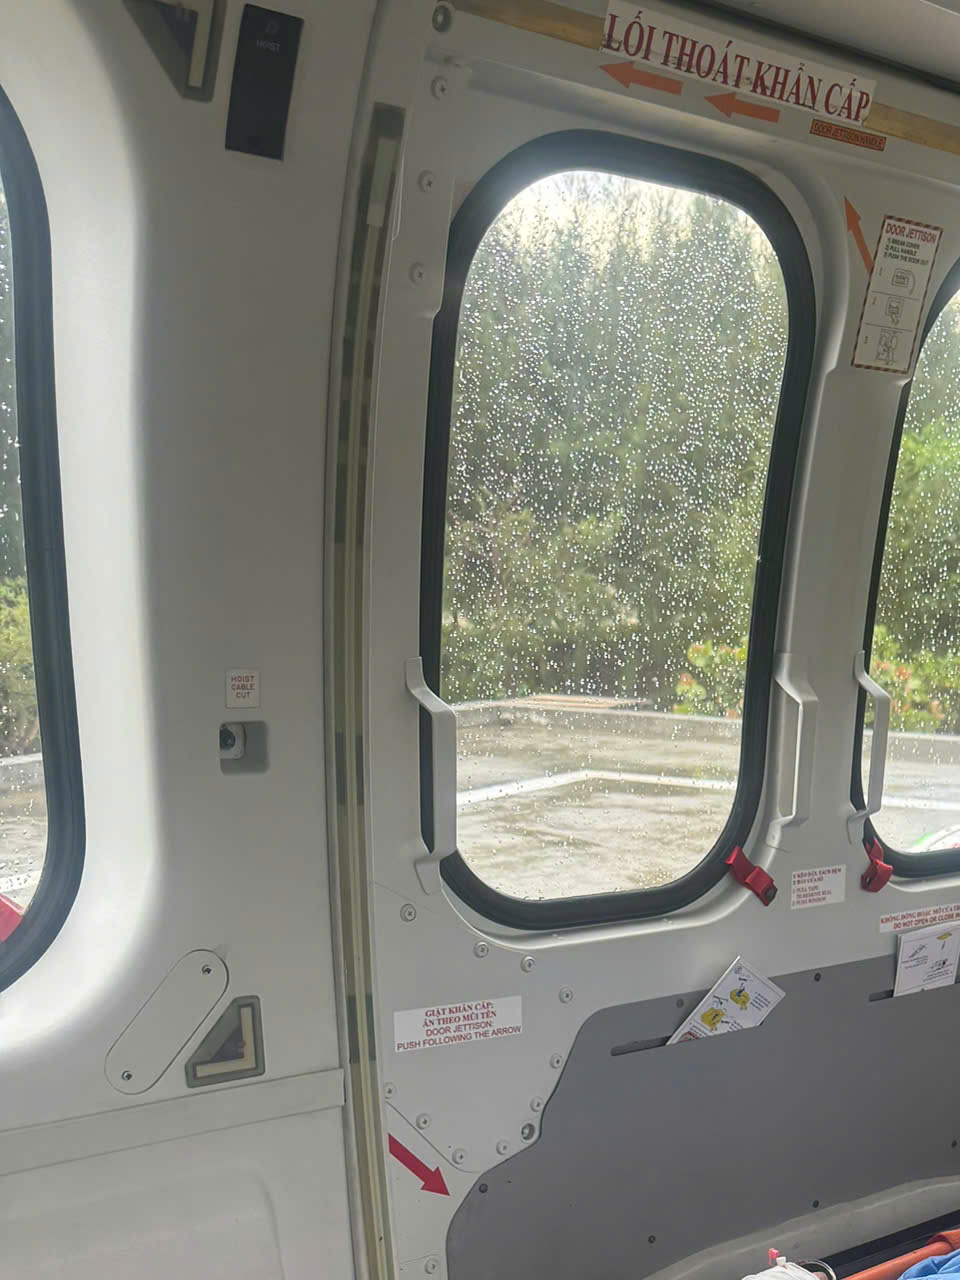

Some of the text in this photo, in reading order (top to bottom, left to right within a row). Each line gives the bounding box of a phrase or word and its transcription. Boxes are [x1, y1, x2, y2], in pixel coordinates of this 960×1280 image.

[603, 10, 870, 122] LỐI THOÁT KHẨN CẤP
[886, 222, 937, 244] DOOR JETTISON
[903, 919, 913, 928] NOT
[914, 917, 928, 926] OPEN
[938, 913, 955, 922] CLOSE
[436, 1015, 460, 1025] THEO
[397, 1026, 521, 1051] PUSH FOLLOWING THE ARROW
[425, 1025, 451, 1037] DOOR
